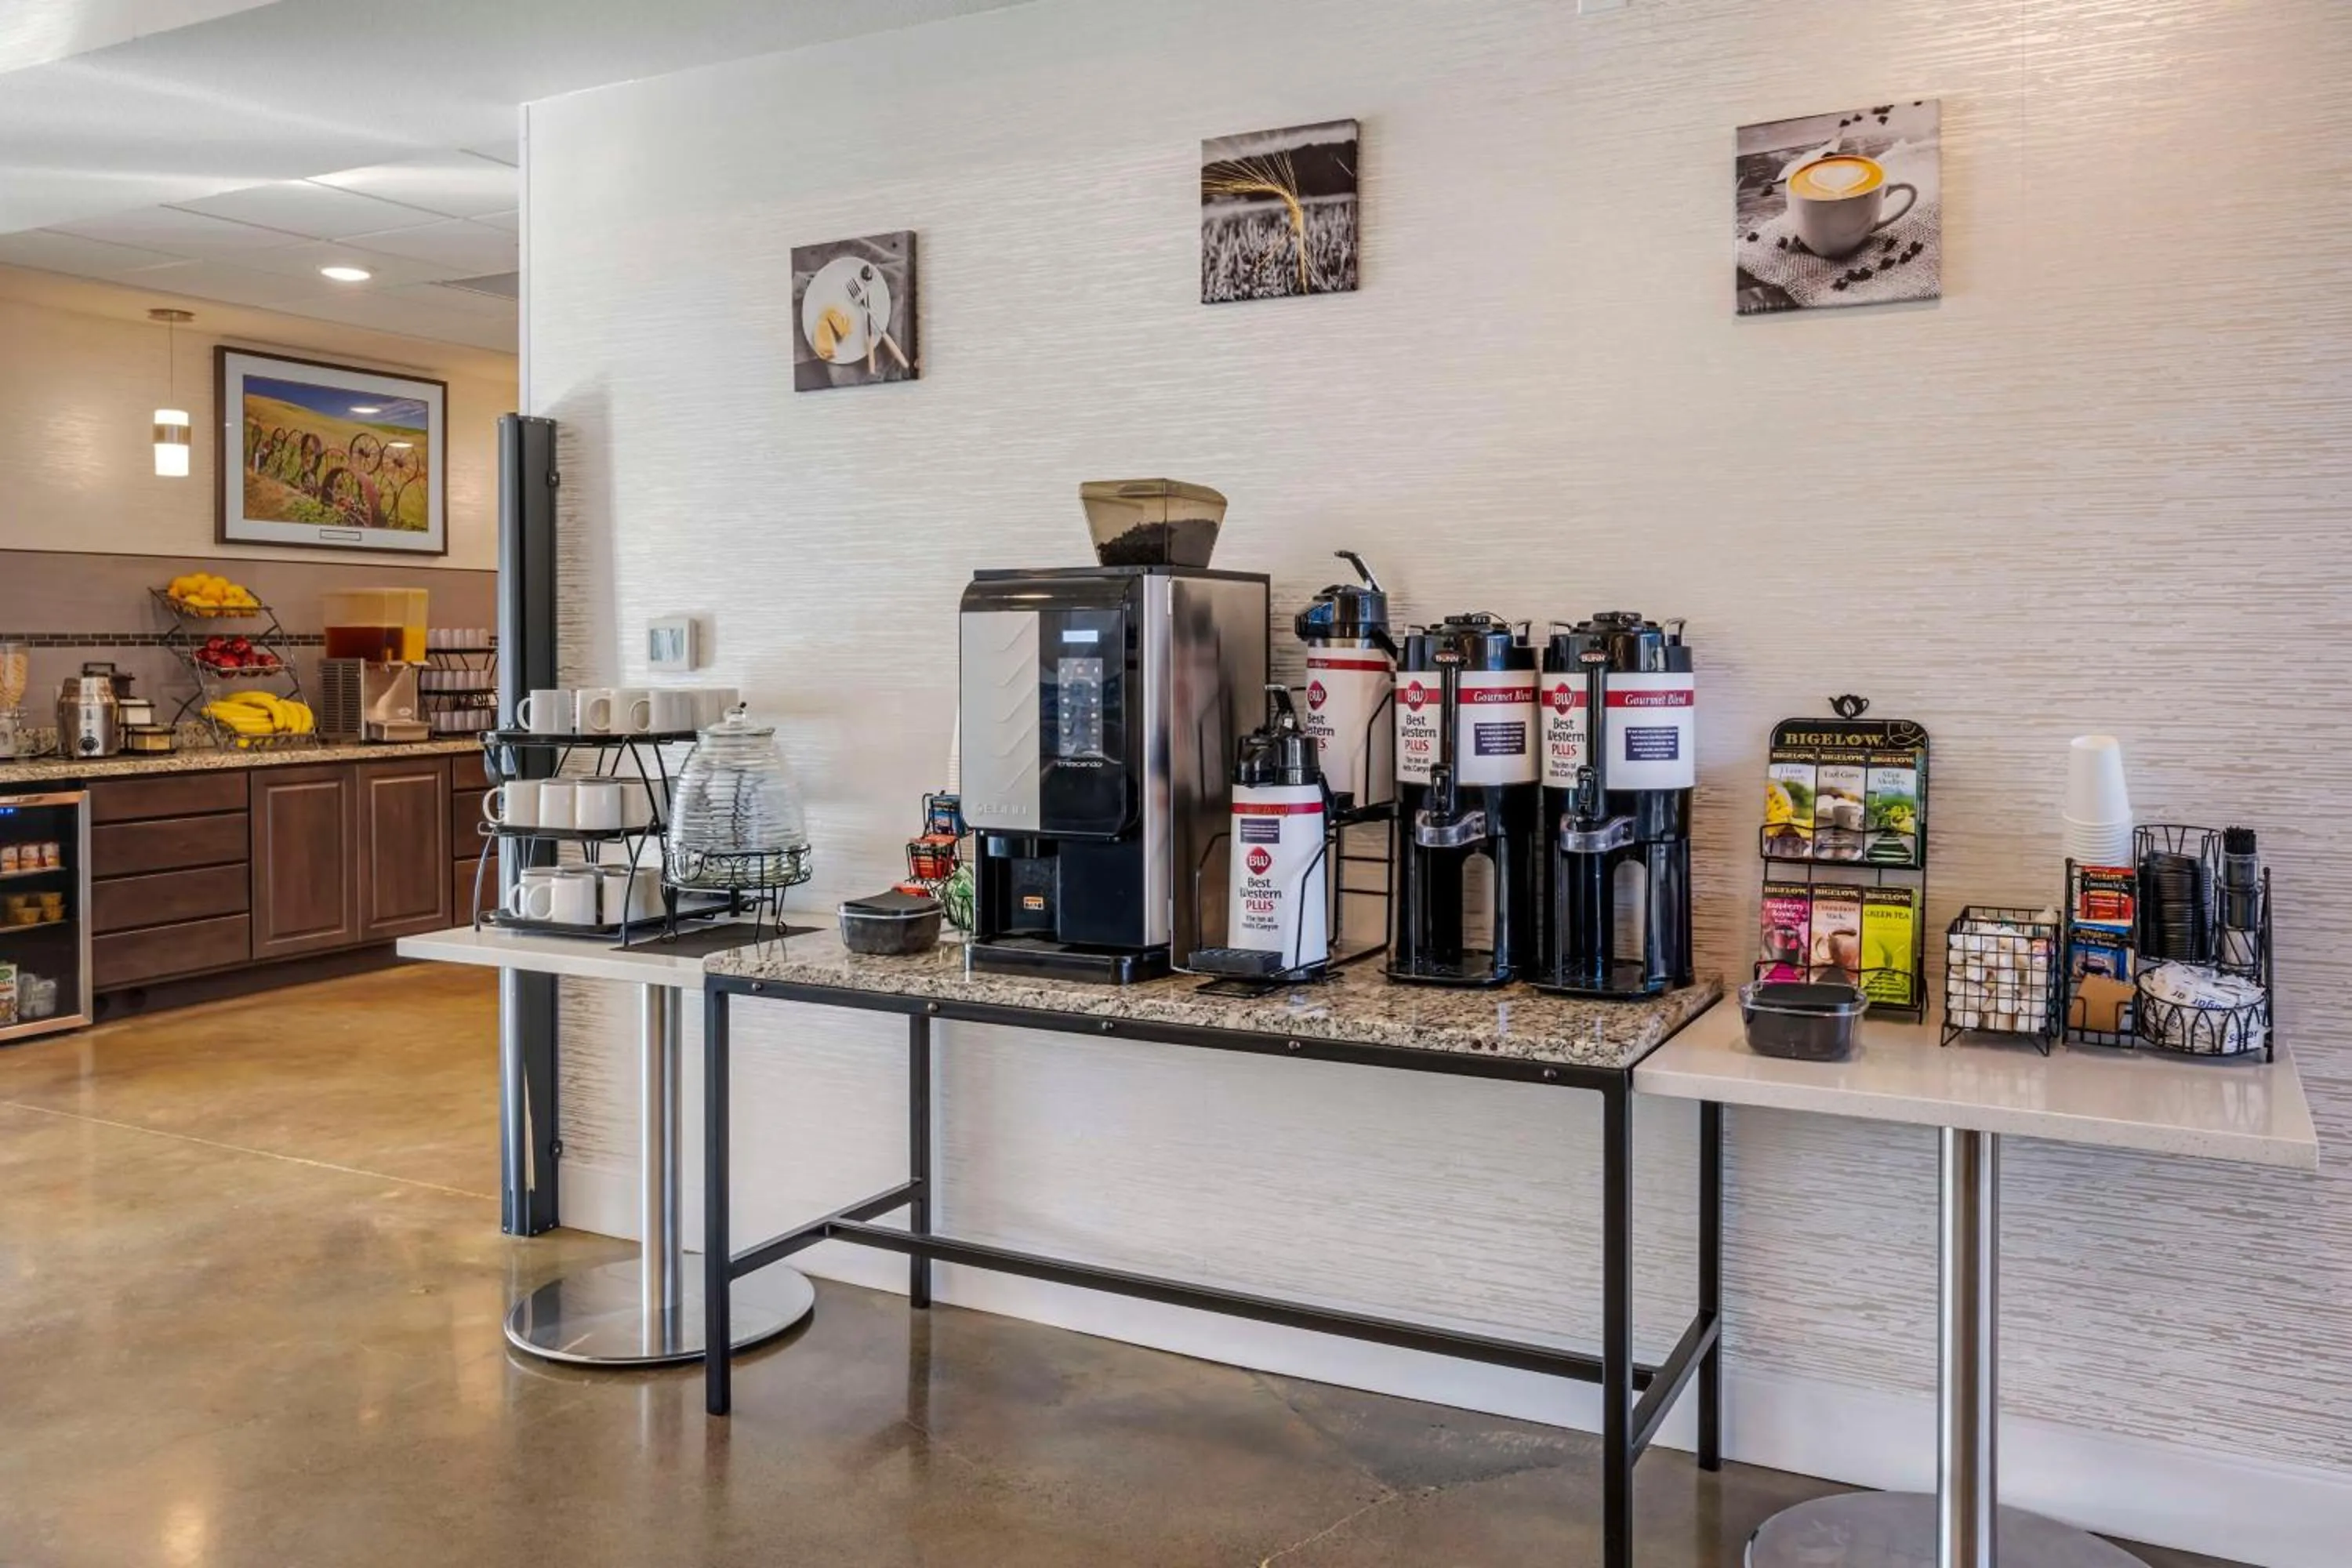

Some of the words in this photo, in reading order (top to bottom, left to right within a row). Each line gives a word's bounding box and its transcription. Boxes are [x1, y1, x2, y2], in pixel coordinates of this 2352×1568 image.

[1407, 690, 1423, 702] BW
[1474, 691, 1512, 702] Gourmet
[1555, 693, 1571, 704] BW
[1625, 694, 1665, 705] Gourmet
[1406, 714, 1425, 725] Best
[1553, 717, 1574, 729] Best
[1401, 727, 1436, 738] Western
[1548, 730, 1585, 742] Western
[1784, 733, 1883, 746] BIGELOW
[1405, 739, 1429, 752] PLUS
[1552, 744, 1577, 756] PLUS
[1249, 855, 1268, 866] BW
[1247, 877, 1271, 888] Best
[1240, 888, 1282, 899] Western
[1246, 900, 1274, 911] PLUS
[1864, 909, 1892, 920] GREEN
[1893, 910, 1909, 920] TEA
